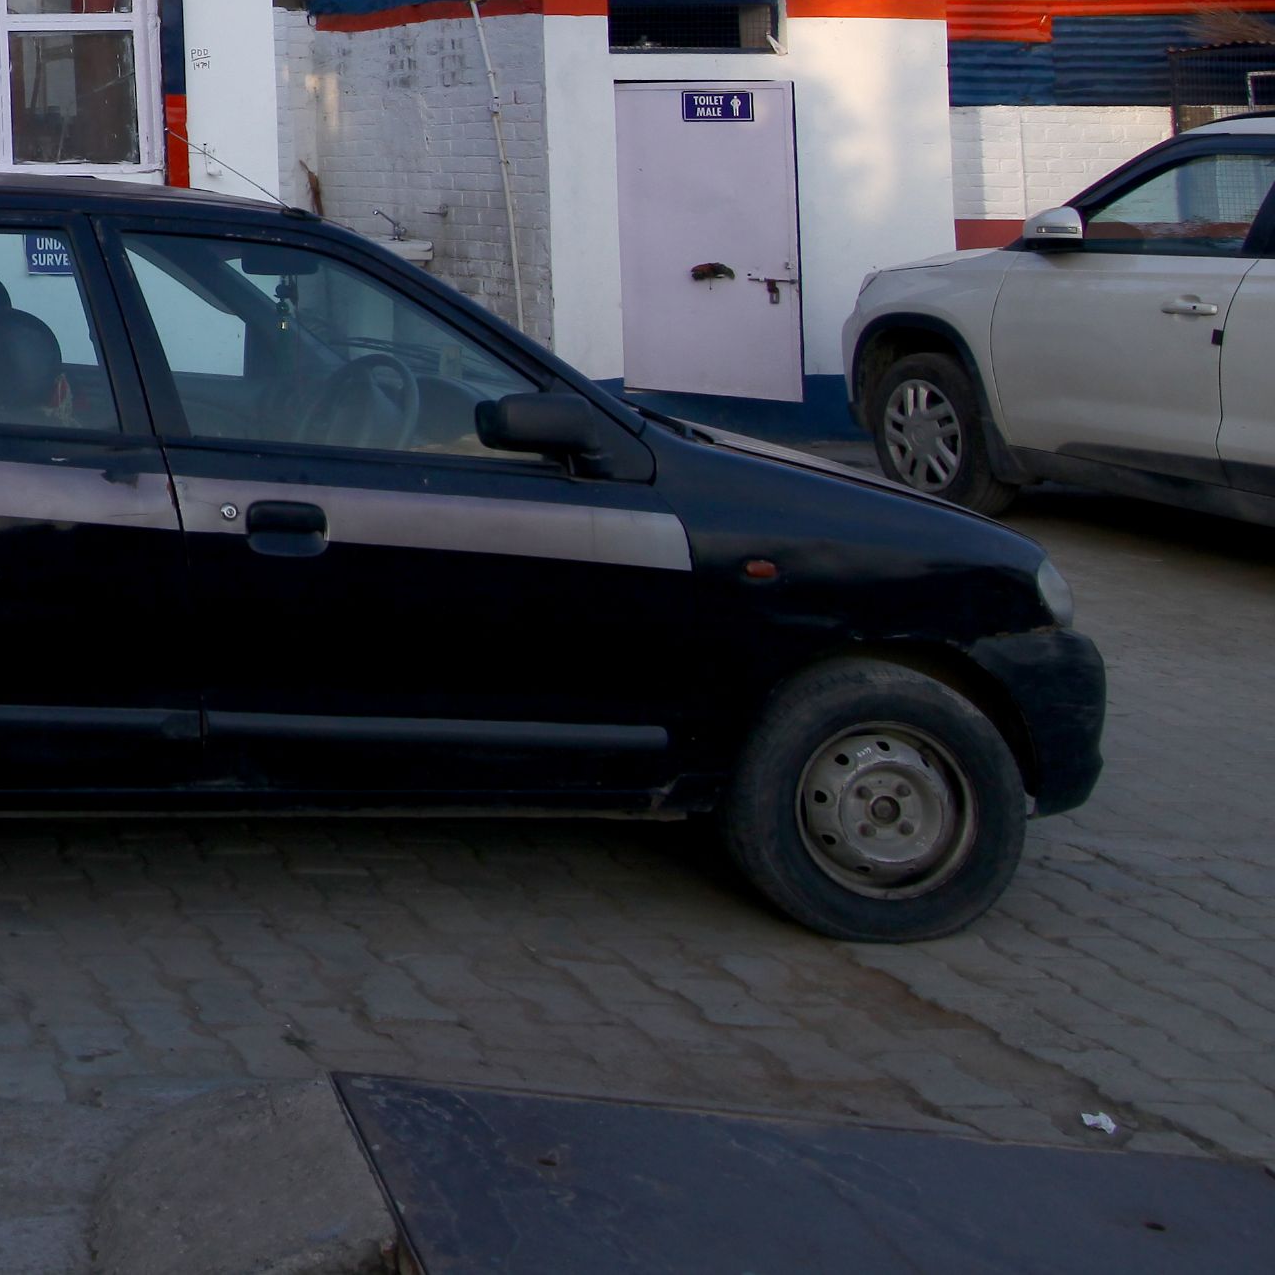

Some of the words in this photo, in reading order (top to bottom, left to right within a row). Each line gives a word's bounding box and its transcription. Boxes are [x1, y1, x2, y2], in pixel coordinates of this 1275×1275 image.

[693, 96, 724, 106] TOILET
[696, 107, 722, 117] MALE
[36, 237, 66, 251] UND
[31, 253, 71, 266] SURVE
